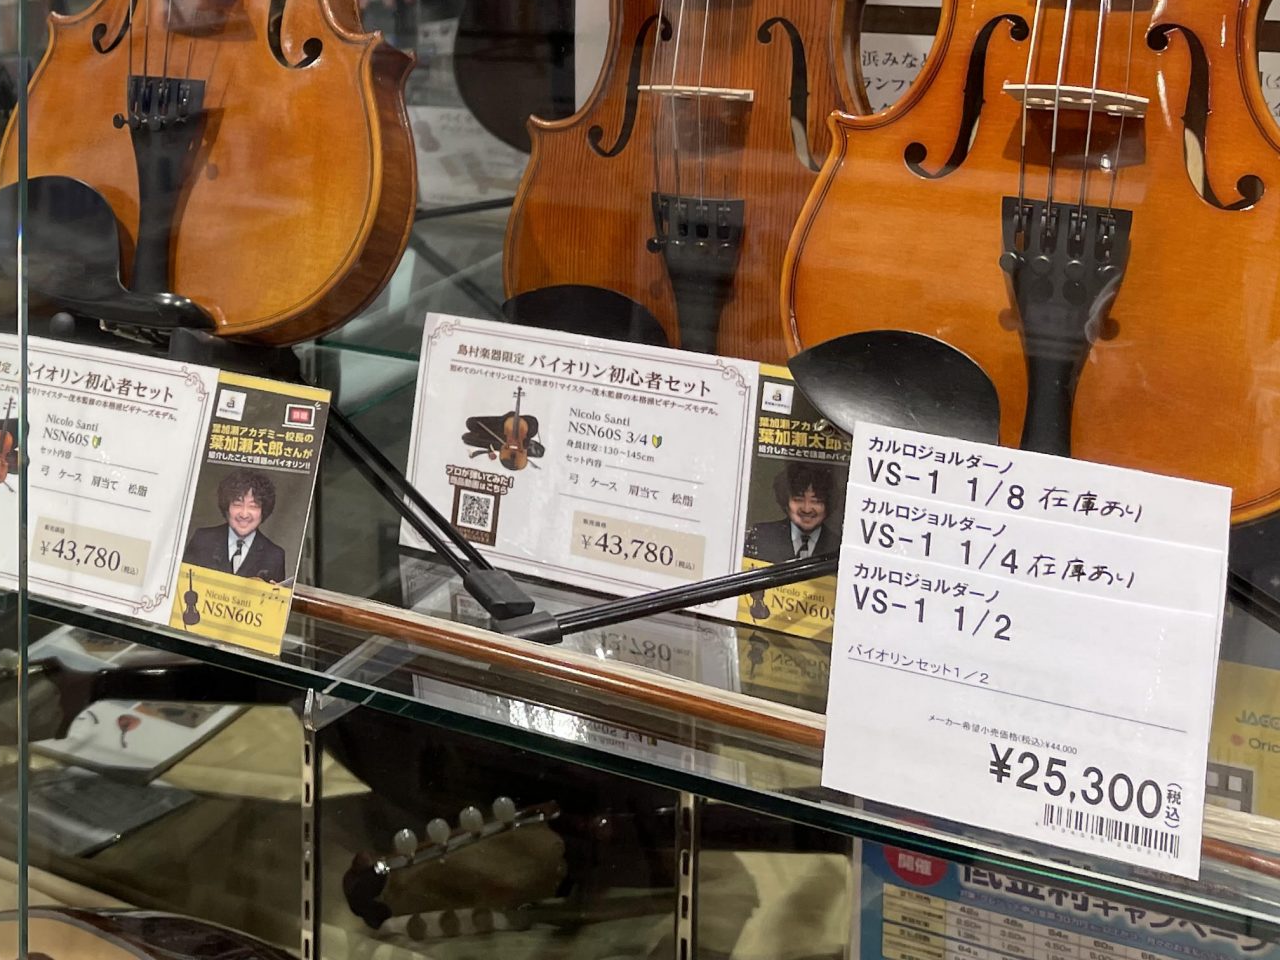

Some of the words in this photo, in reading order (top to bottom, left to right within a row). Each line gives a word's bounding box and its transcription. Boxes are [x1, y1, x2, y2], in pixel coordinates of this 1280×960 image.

[457, 343, 525, 366] 島村楽器限定
[529, 354, 711, 397] バイオリン初心者セット
[46, 414, 74, 428] Nicolo
[76, 419, 99, 432] Santi
[568, 421, 622, 441] NSN60S
[626, 431, 648, 446] 3/4
[569, 407, 601, 422] Nicolo
[604, 413, 631, 427] Santi
[759, 416, 811, 431] 葉加瀬アカ
[40, 446, 72, 460] セット内容
[43, 427, 90, 447] NSN60S
[209, 434, 314, 459] 葉加瀬太郎さんが
[565, 453, 602, 468] セット内容
[868, 436, 1014, 475] カルロジョルダーノ
[59, 469, 82, 483] ケース
[91, 475, 119, 491] 肩当て
[589, 477, 618, 492] ケース
[628, 484, 660, 500] 肩当て
[672, 492, 694, 507] 松脂
[867, 456, 940, 494] VS-1
[967, 477, 1026, 511] 1/8
[861, 497, 1007, 537] カルロジョルダーノ
[1038, 486, 1143, 523] 在庫あり
[40, 538, 121, 572] ¥43,780
[581, 532, 674, 566] ¥43,780
[860, 518, 933, 558] VS-1
[960, 539, 1019, 575] 1/4
[854, 562, 1000, 603] カルロジョルダーノ
[1027, 554, 1135, 589] 在庫あり
[202, 600, 263, 628] NSN60S
[205, 589, 230, 602] Nicolo
[231, 595, 251, 608] Santi
[852, 584, 926, 623] VS-1
[954, 605, 1012, 642] 1/2
[989, 742, 1163, 819] ¥25,300
[1164, 782, 1183, 829] (税込)
